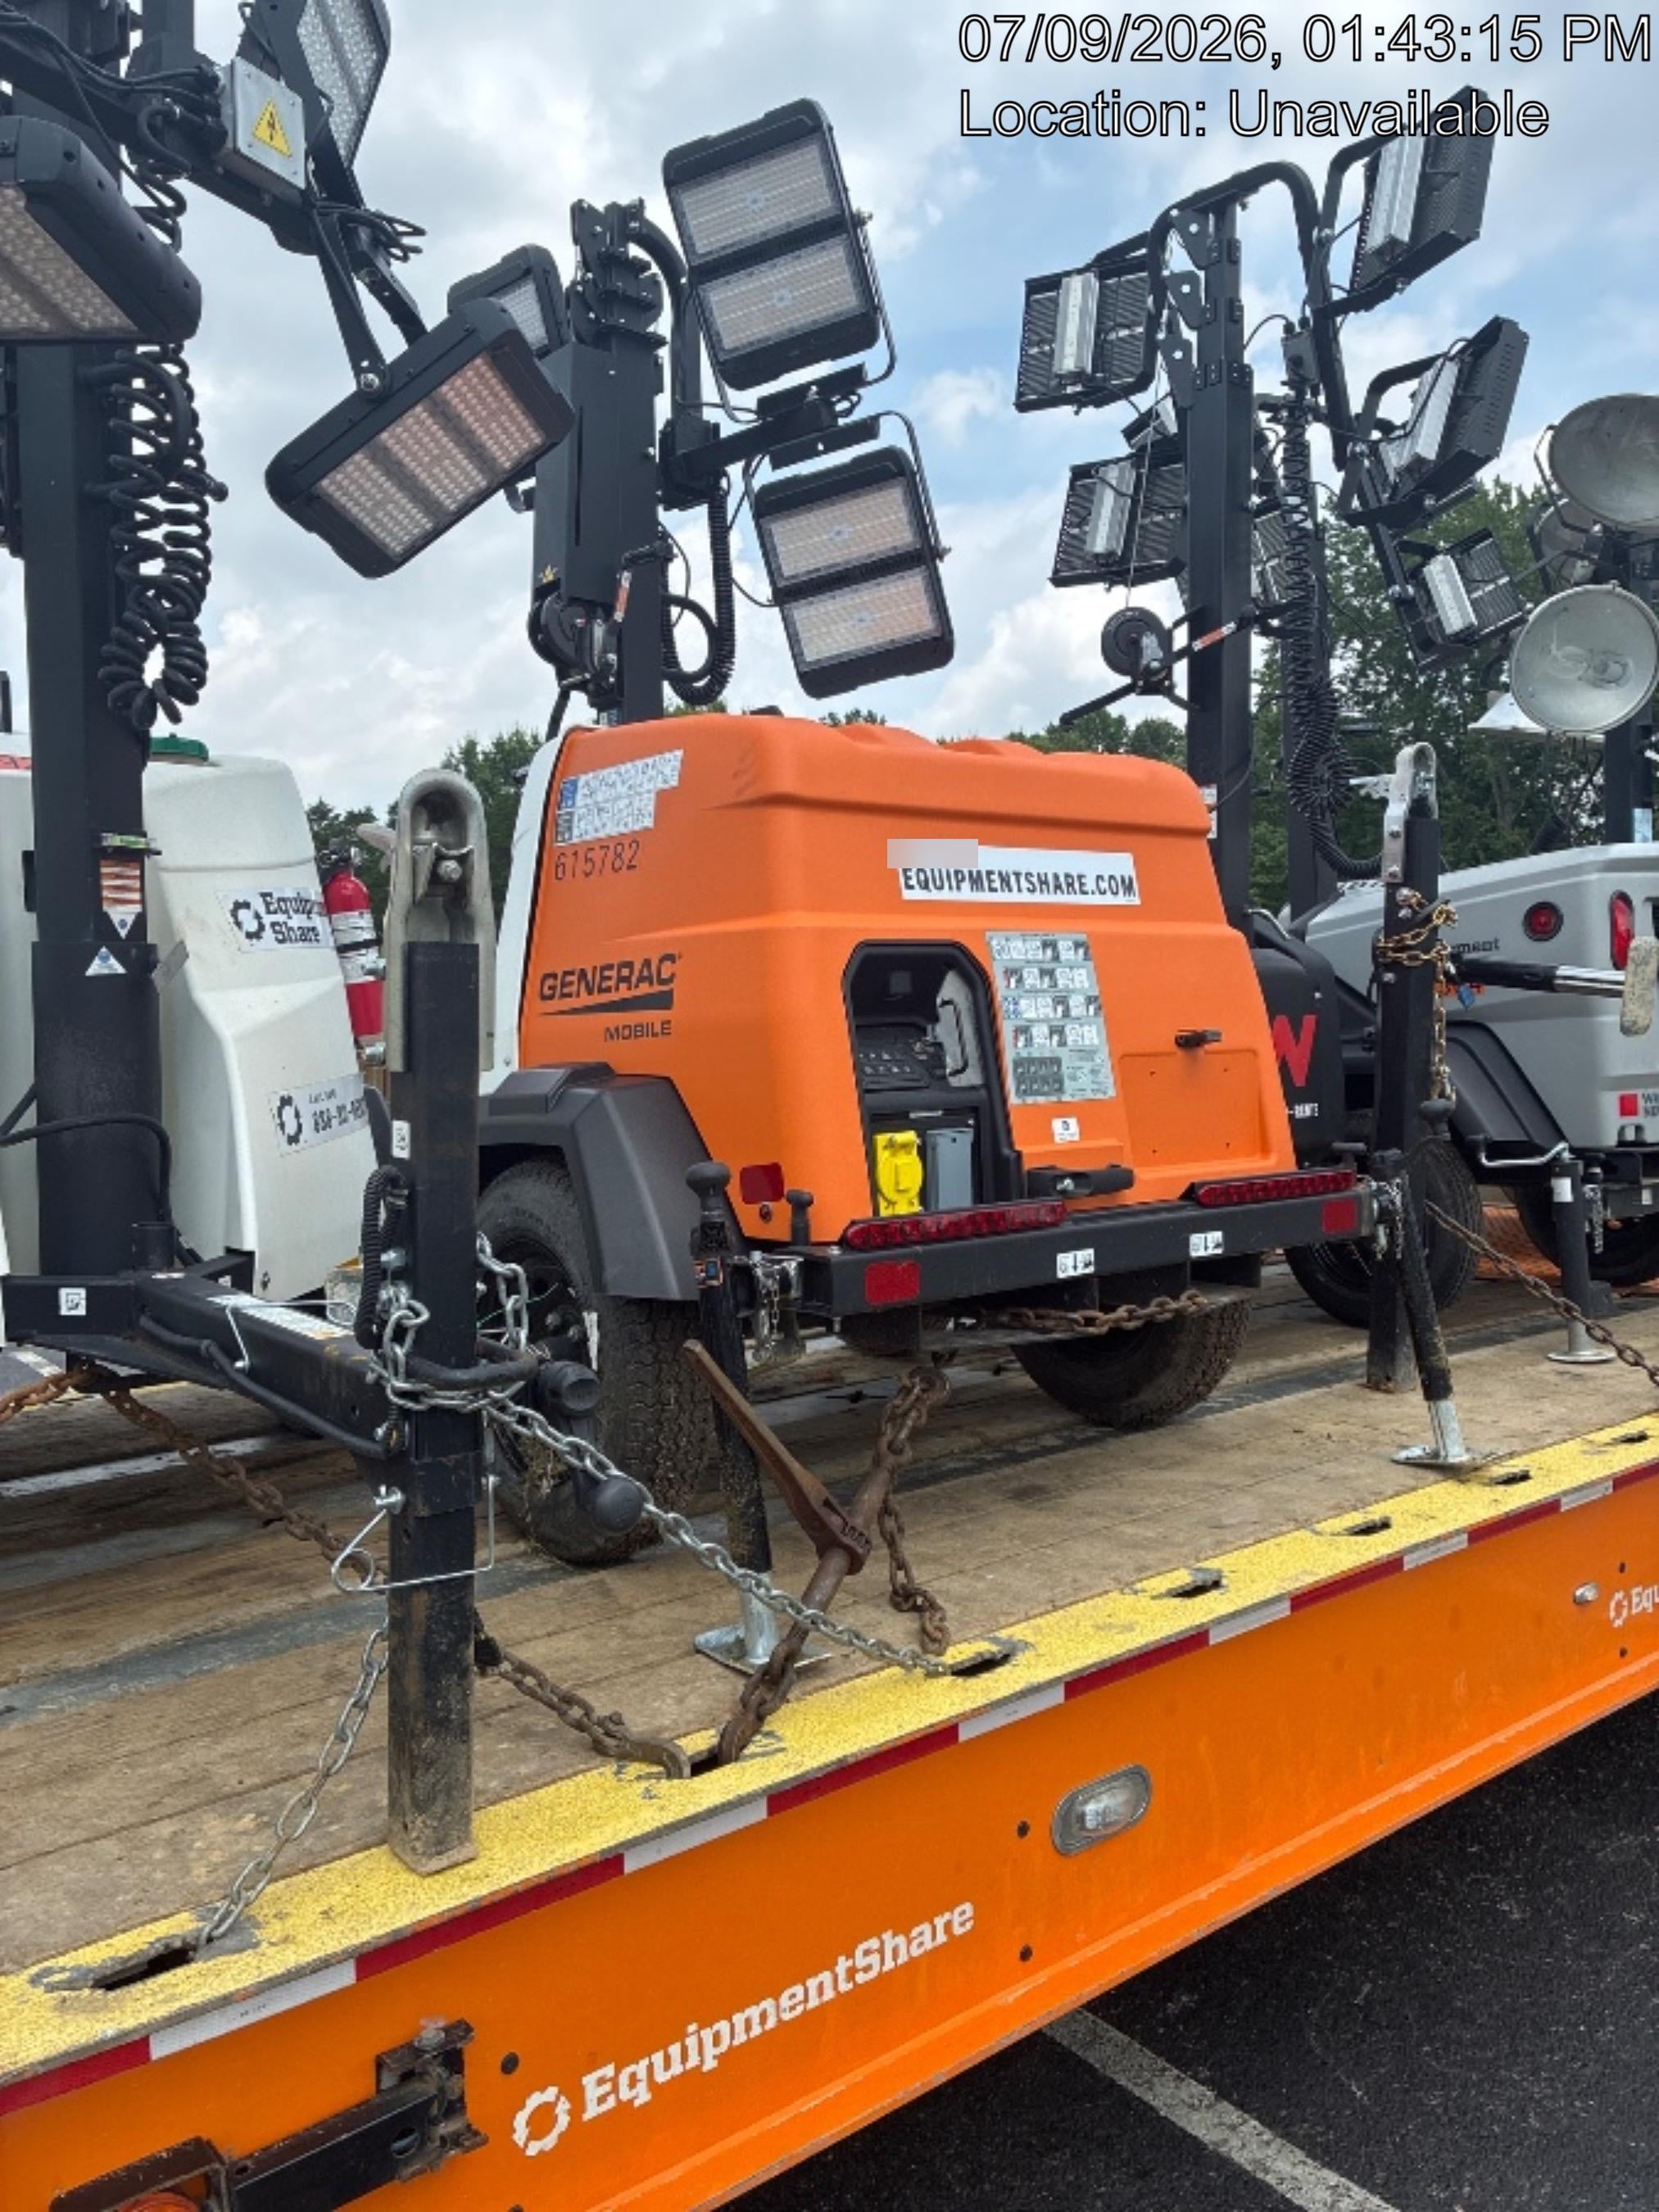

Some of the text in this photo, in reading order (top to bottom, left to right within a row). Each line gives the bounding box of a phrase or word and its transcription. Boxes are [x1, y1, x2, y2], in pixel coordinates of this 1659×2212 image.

[555, 840, 640, 881] 615782
[901, 868, 1137, 898] EQUIPMENTSHARE.COM
[270, 921, 321, 944] Share
[540, 953, 677, 1001] GENERAC
[604, 1020, 672, 1043] MOBILE
[581, 1902, 974, 2122] EquipmentShare
